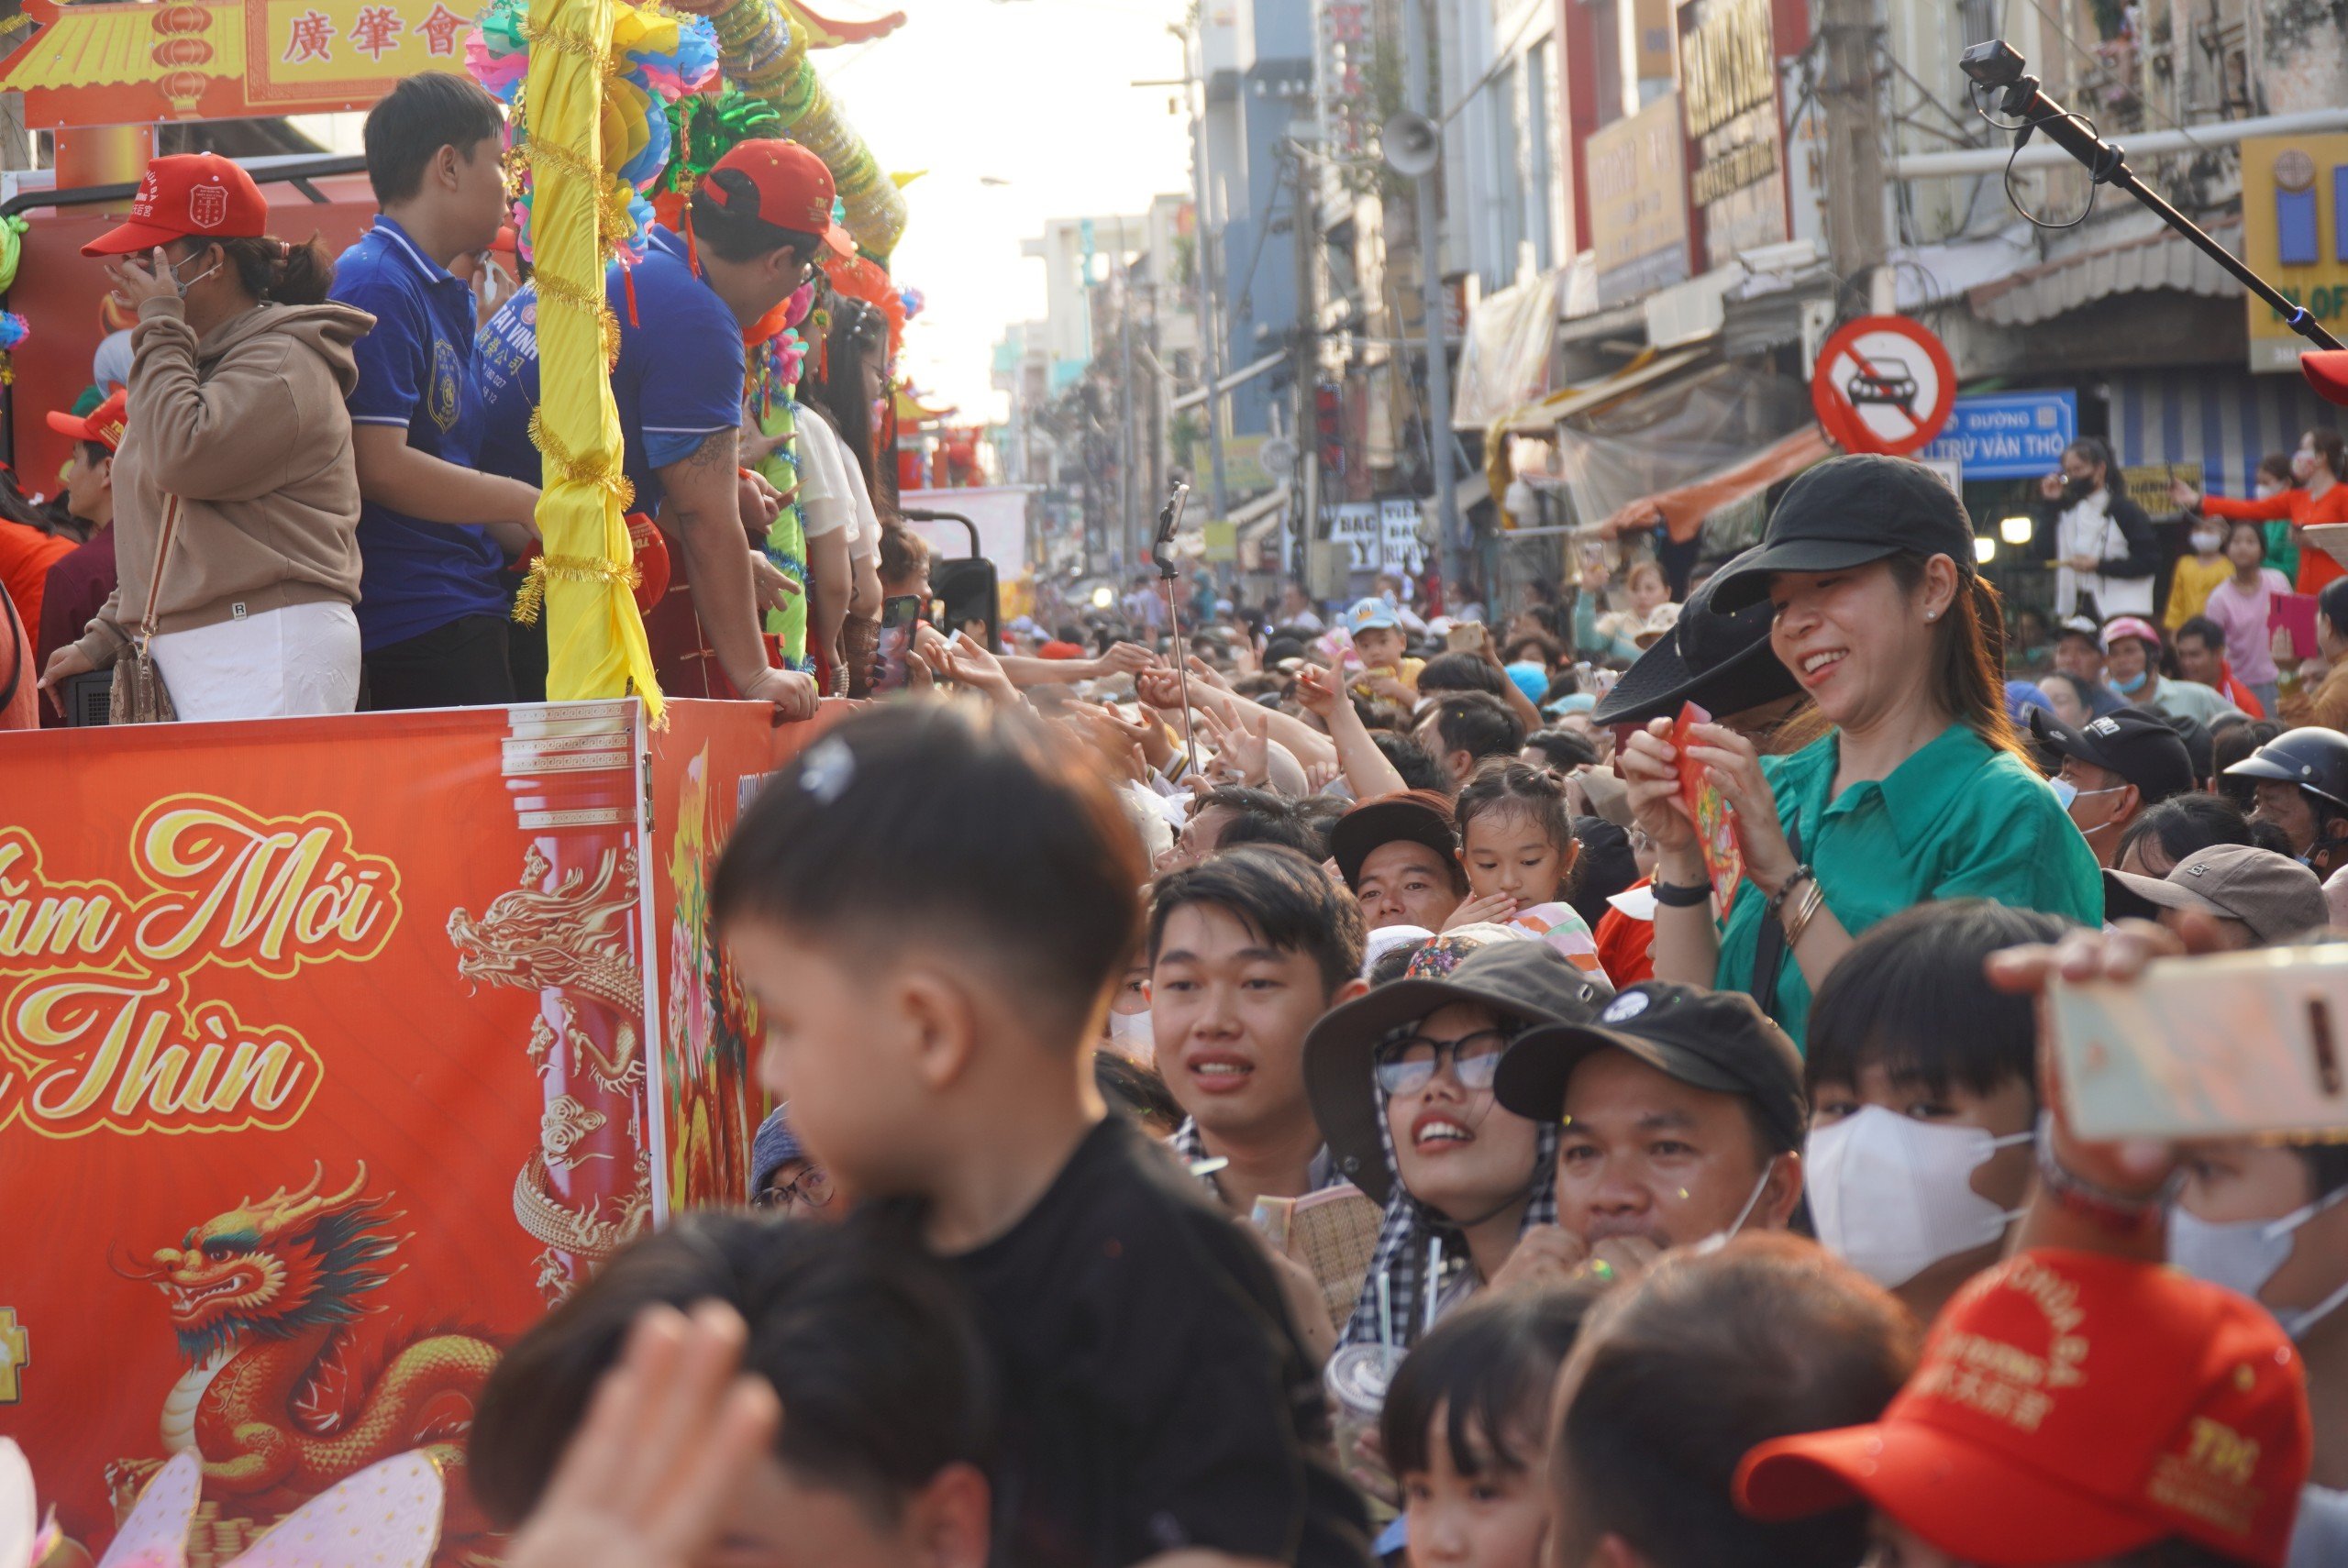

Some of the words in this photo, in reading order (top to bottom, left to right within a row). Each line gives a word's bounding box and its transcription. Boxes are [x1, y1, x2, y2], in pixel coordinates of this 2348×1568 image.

[282, 3, 473, 63] 廣肇會
[1968, 410, 2031, 433] ĐƯỜNG
[1981, 432, 2021, 458] VĂN
[0, 840, 122, 957] ăm
[135, 807, 383, 961] Mới
[17, 977, 305, 1121] Thìn
